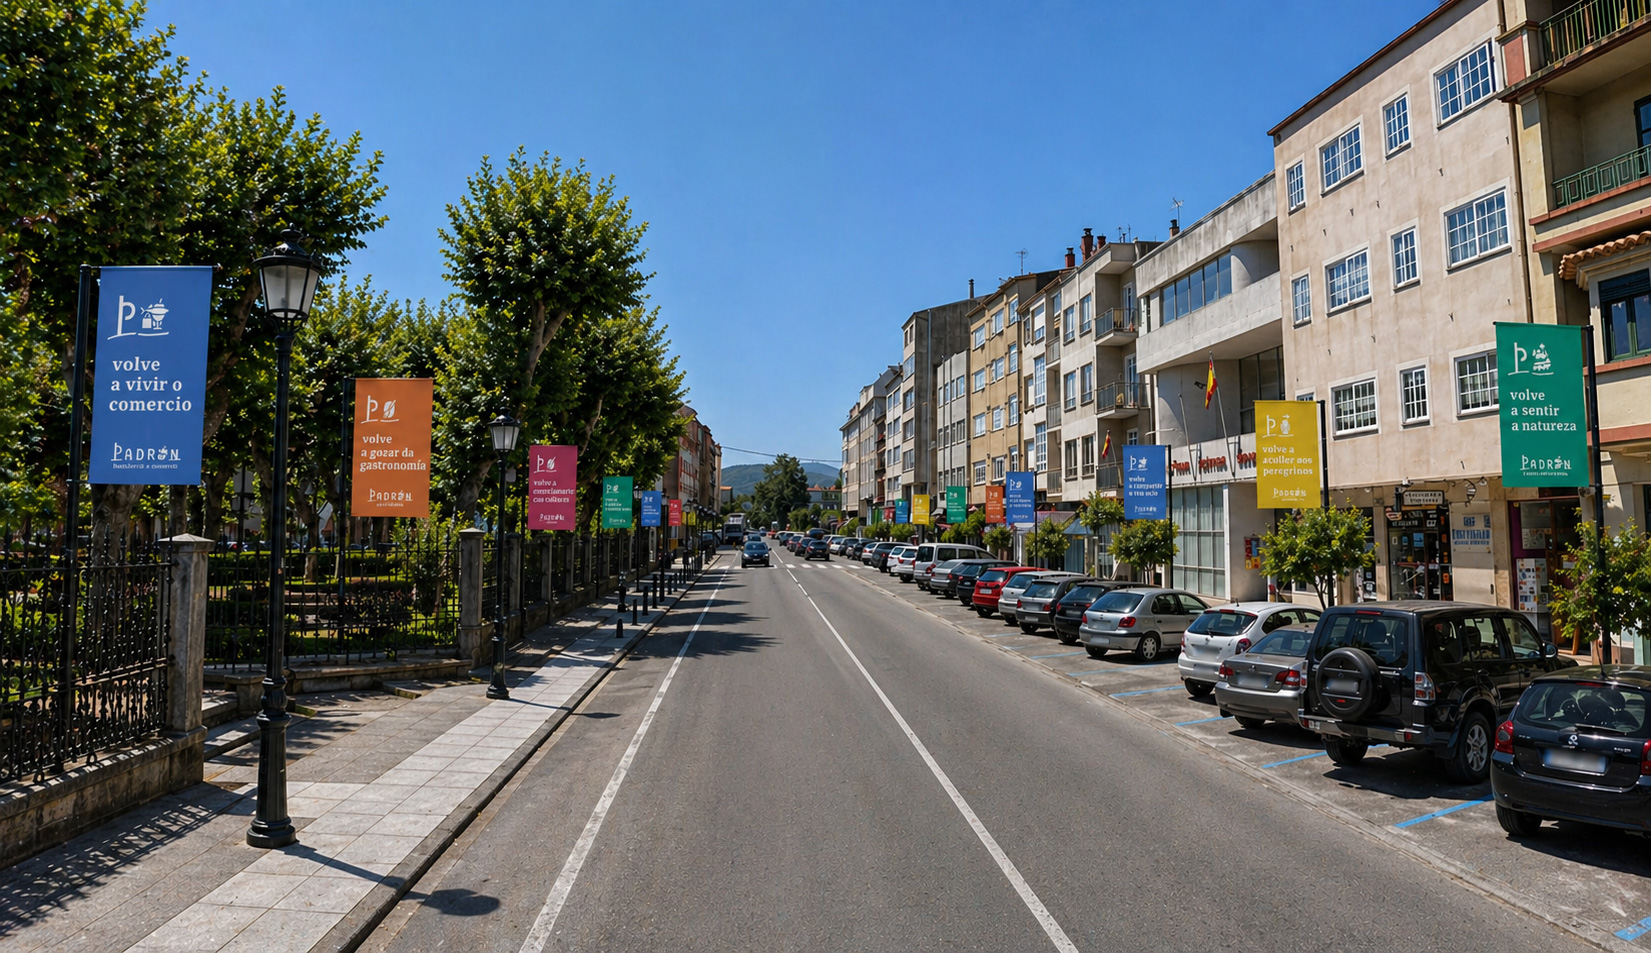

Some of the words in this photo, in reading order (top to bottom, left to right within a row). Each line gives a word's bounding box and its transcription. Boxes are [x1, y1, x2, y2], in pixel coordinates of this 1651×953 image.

[112, 356, 160, 371] volve
[111, 380, 120, 391] a
[125, 377, 167, 391] vivir
[172, 380, 182, 391] o
[1510, 389, 1545, 400] volve
[109, 397, 192, 412] comercio
[1511, 406, 1518, 416] a
[1522, 405, 1560, 416] sentir
[1512, 422, 1519, 431] a
[1522, 420, 1577, 431] natureza
[362, 434, 392, 444] volve
[361, 449, 367, 457] a
[370, 449, 399, 460] gozar
[402, 448, 414, 457] da
[1262, 444, 1287, 453] volve
[360, 460, 426, 472] gastronomía
[1263, 466, 1313, 477] peregrinos
